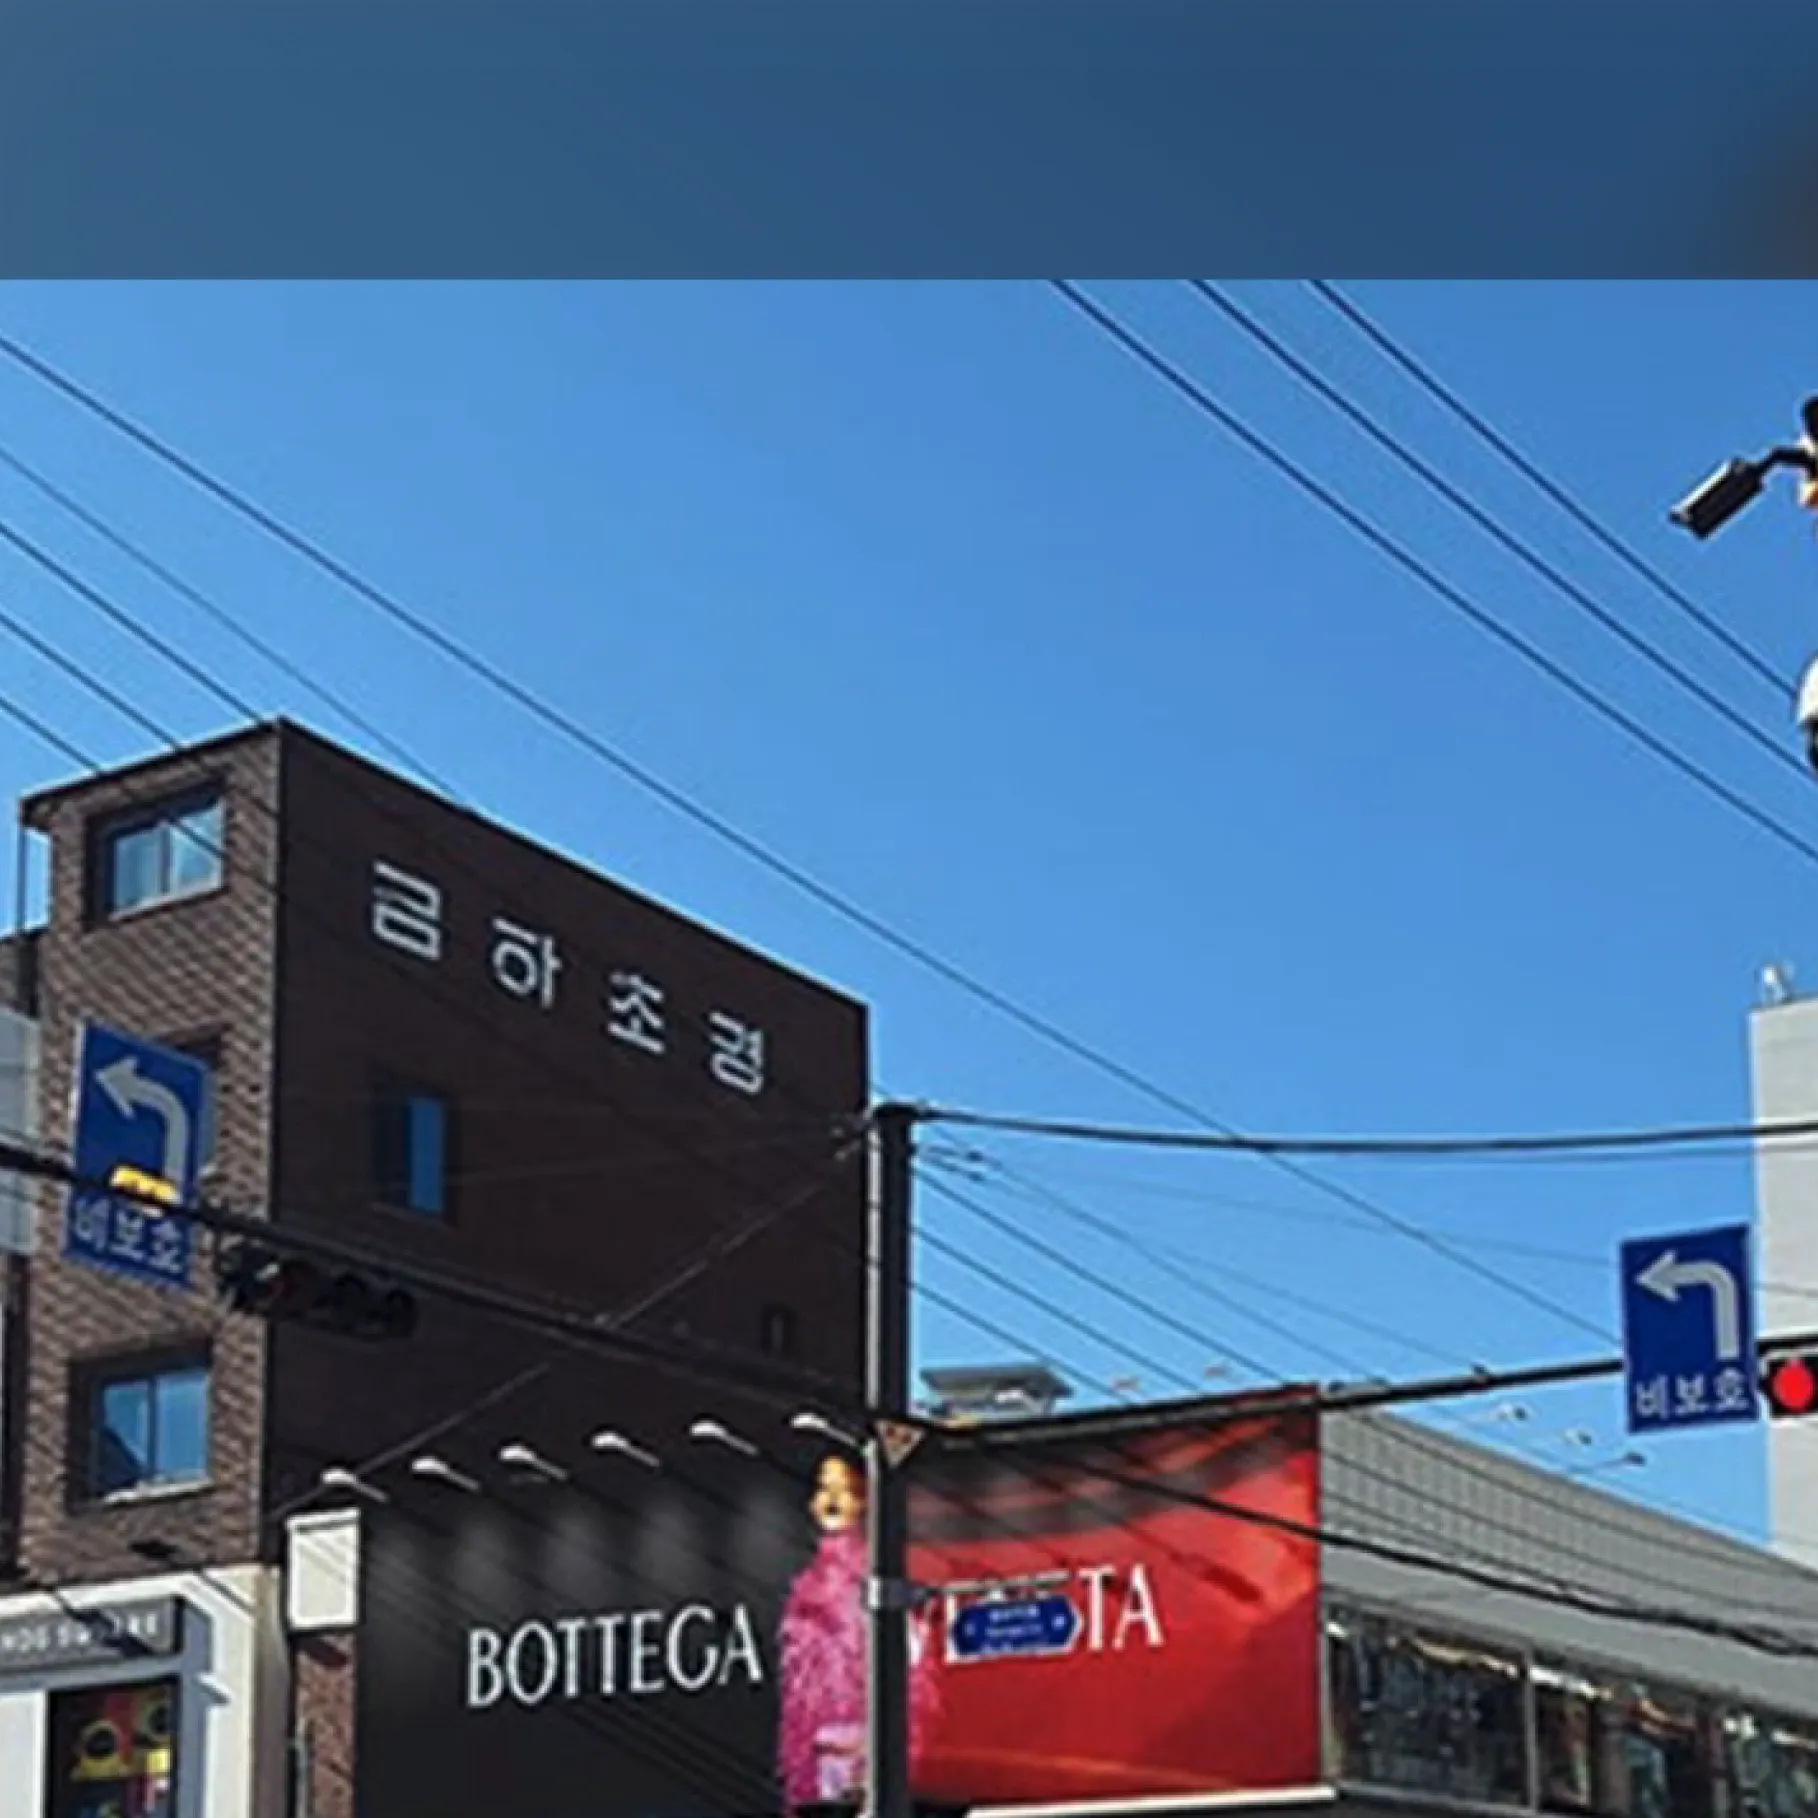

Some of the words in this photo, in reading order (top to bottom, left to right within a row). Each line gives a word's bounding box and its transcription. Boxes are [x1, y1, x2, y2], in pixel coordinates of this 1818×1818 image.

[75, 1196, 182, 1274] 비보호
[1635, 1367, 1750, 1420] 비보호
[467, 1603, 764, 1707] BOTTEGA
